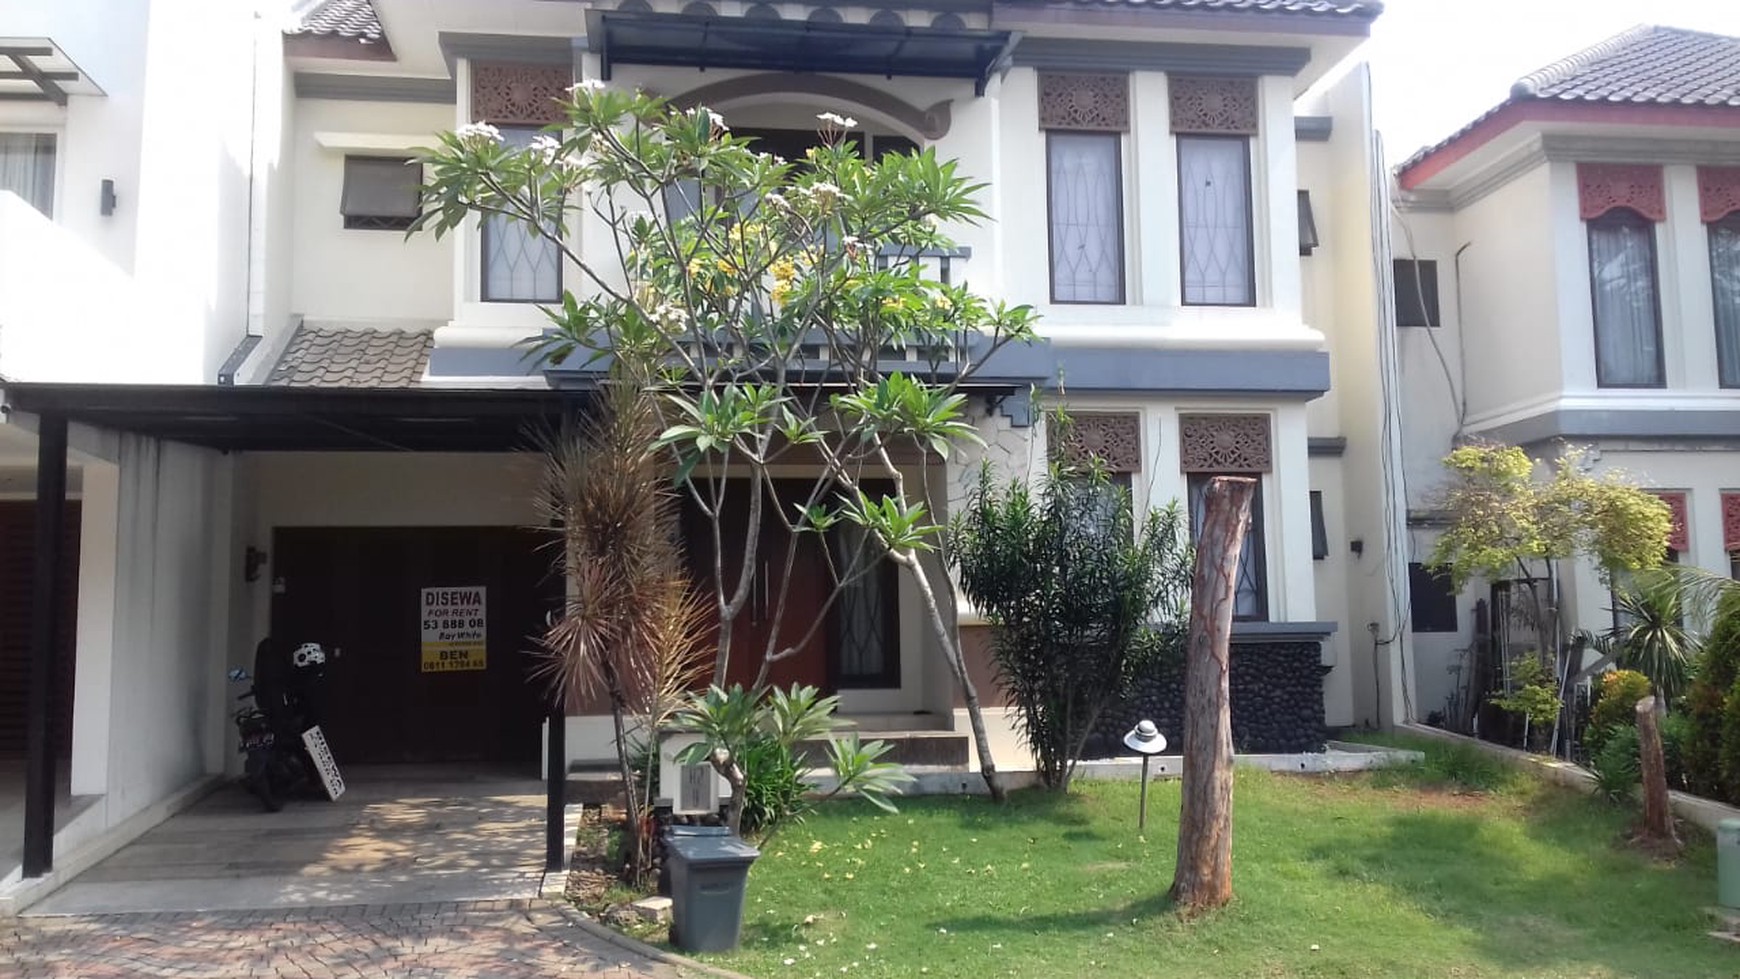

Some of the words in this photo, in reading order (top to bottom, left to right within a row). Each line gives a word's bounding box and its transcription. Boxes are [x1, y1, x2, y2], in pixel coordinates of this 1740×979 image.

[426, 591, 481, 605] DISEWA
[428, 609, 449, 617] FOR
[451, 608, 479, 617] RENT
[424, 620, 438, 630] 53
[440, 650, 468, 660] BEN
